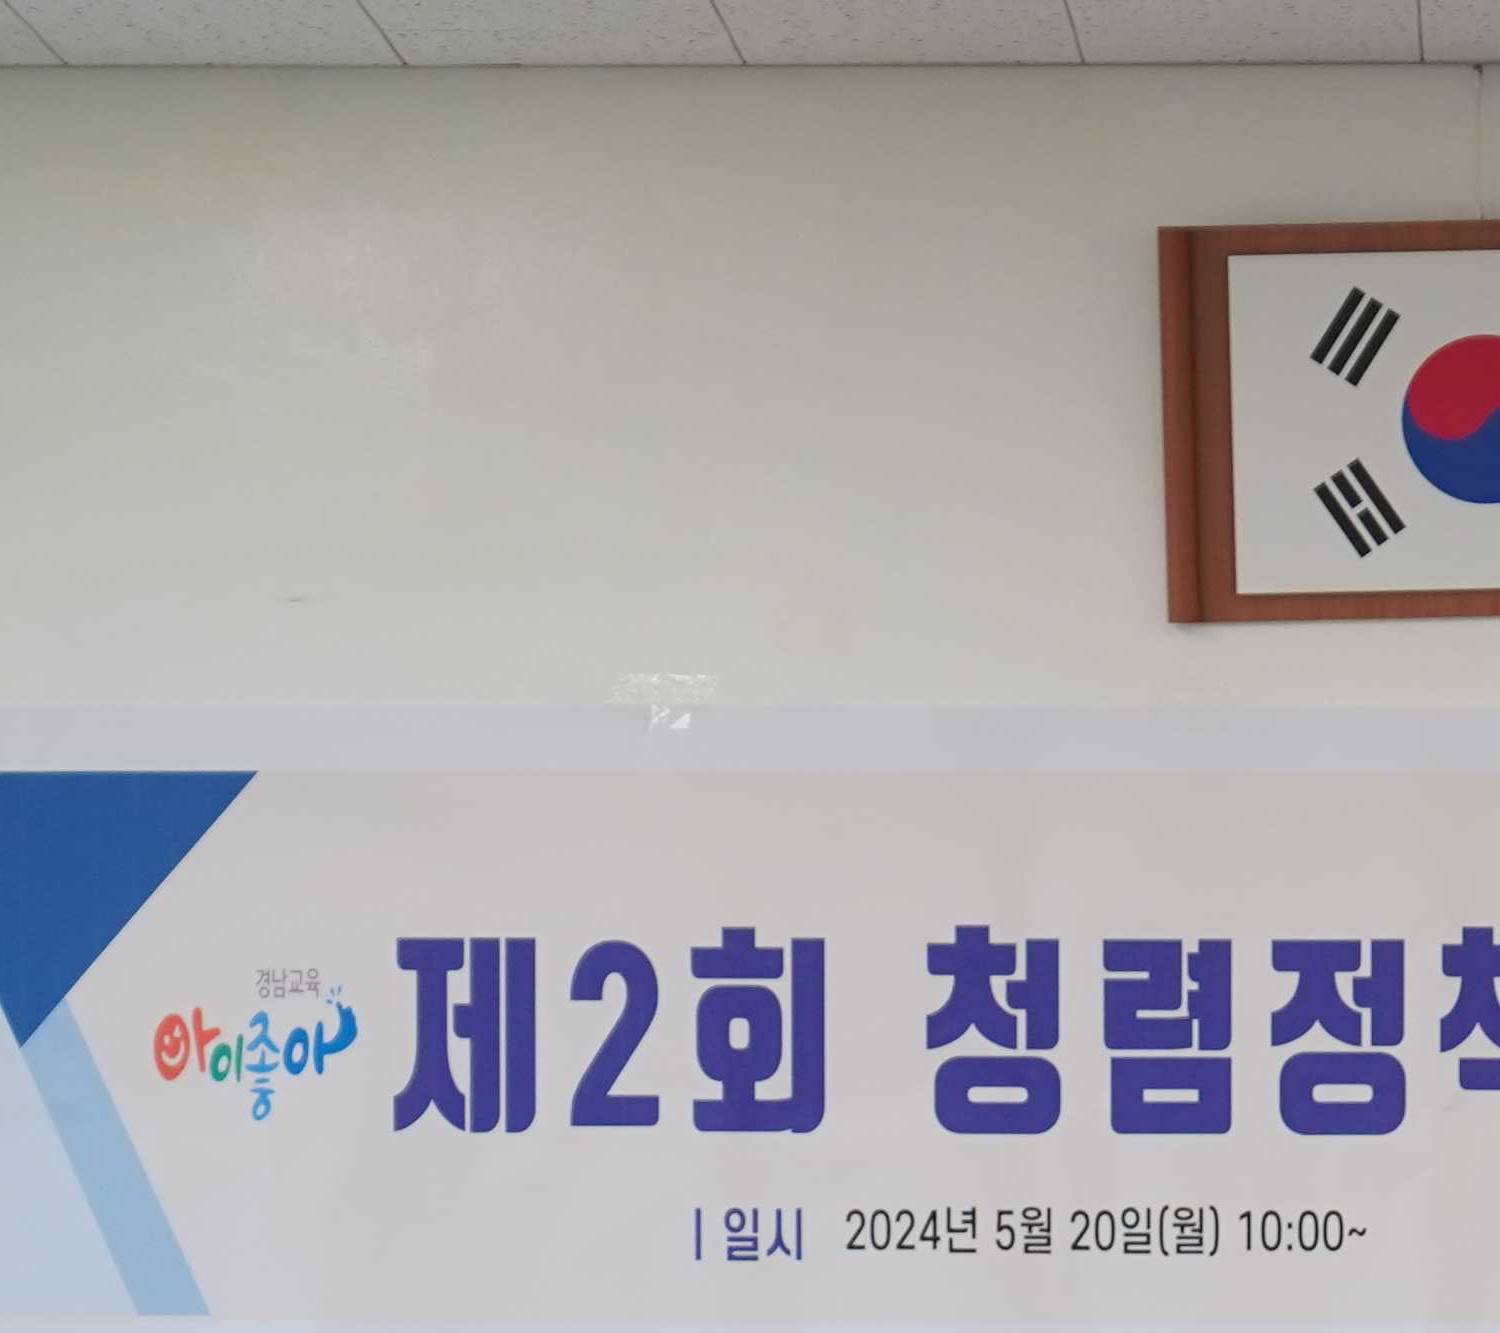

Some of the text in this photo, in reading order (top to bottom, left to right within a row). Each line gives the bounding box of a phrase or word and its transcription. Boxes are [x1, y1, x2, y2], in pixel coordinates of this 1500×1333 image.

[255, 967, 321, 999] 경남교육
[153, 1004, 358, 1122] 아이좋아
[393, 926, 826, 1134] 제2회
[722, 1204, 1368, 1261] 일시 2024년 5월 20일(월) 10:00~
